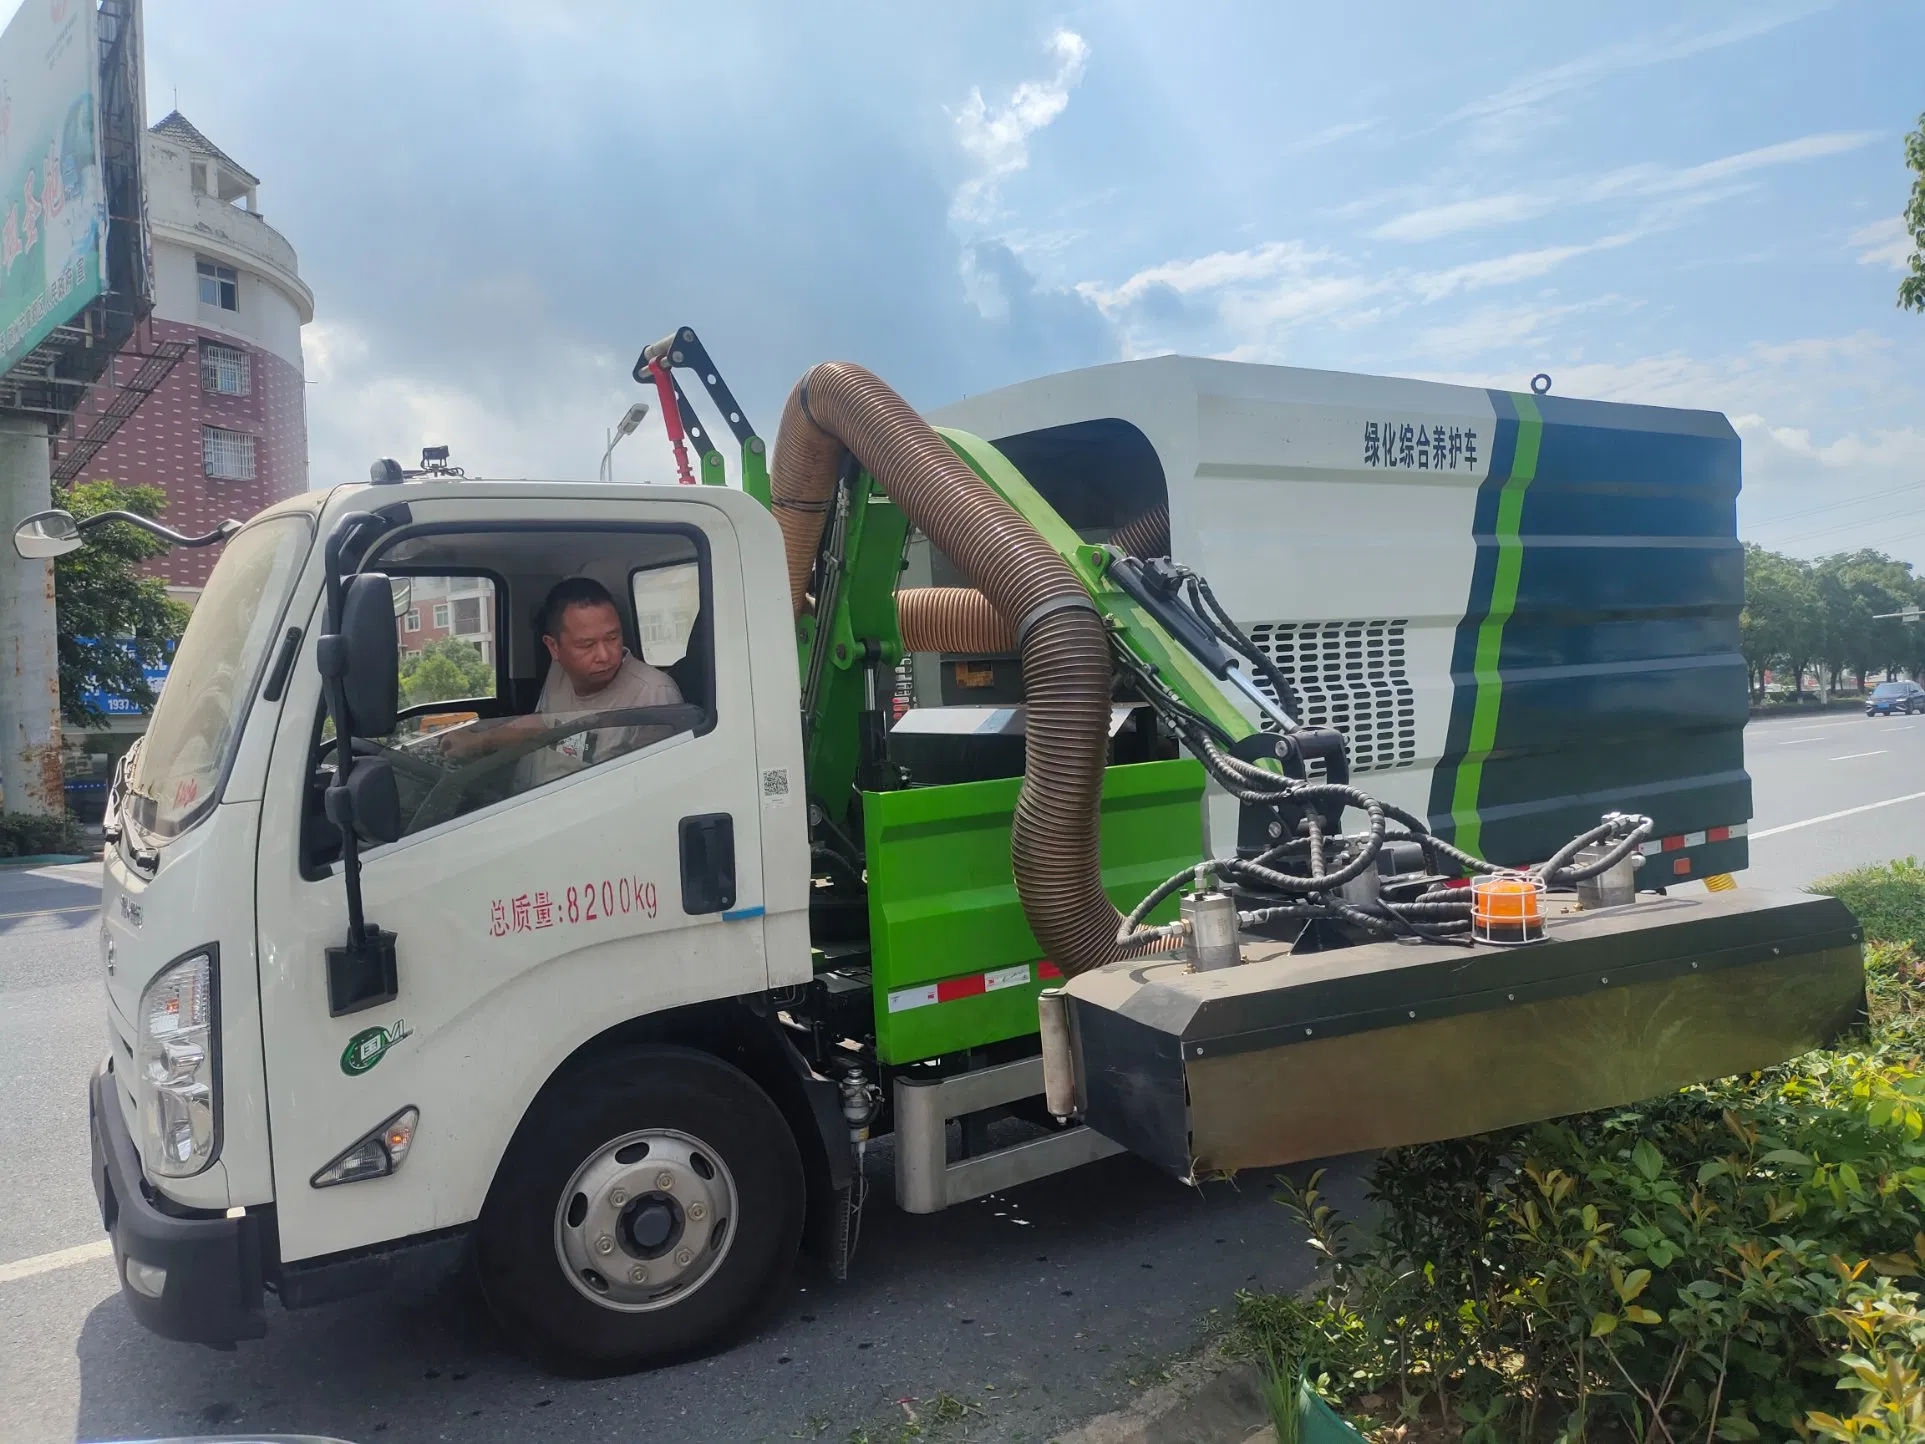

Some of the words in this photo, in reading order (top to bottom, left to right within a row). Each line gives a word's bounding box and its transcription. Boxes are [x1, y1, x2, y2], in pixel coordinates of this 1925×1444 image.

[1364, 421, 1478, 472] 绿化综合养护车
[489, 875, 657, 937] 总质量:8200kg
